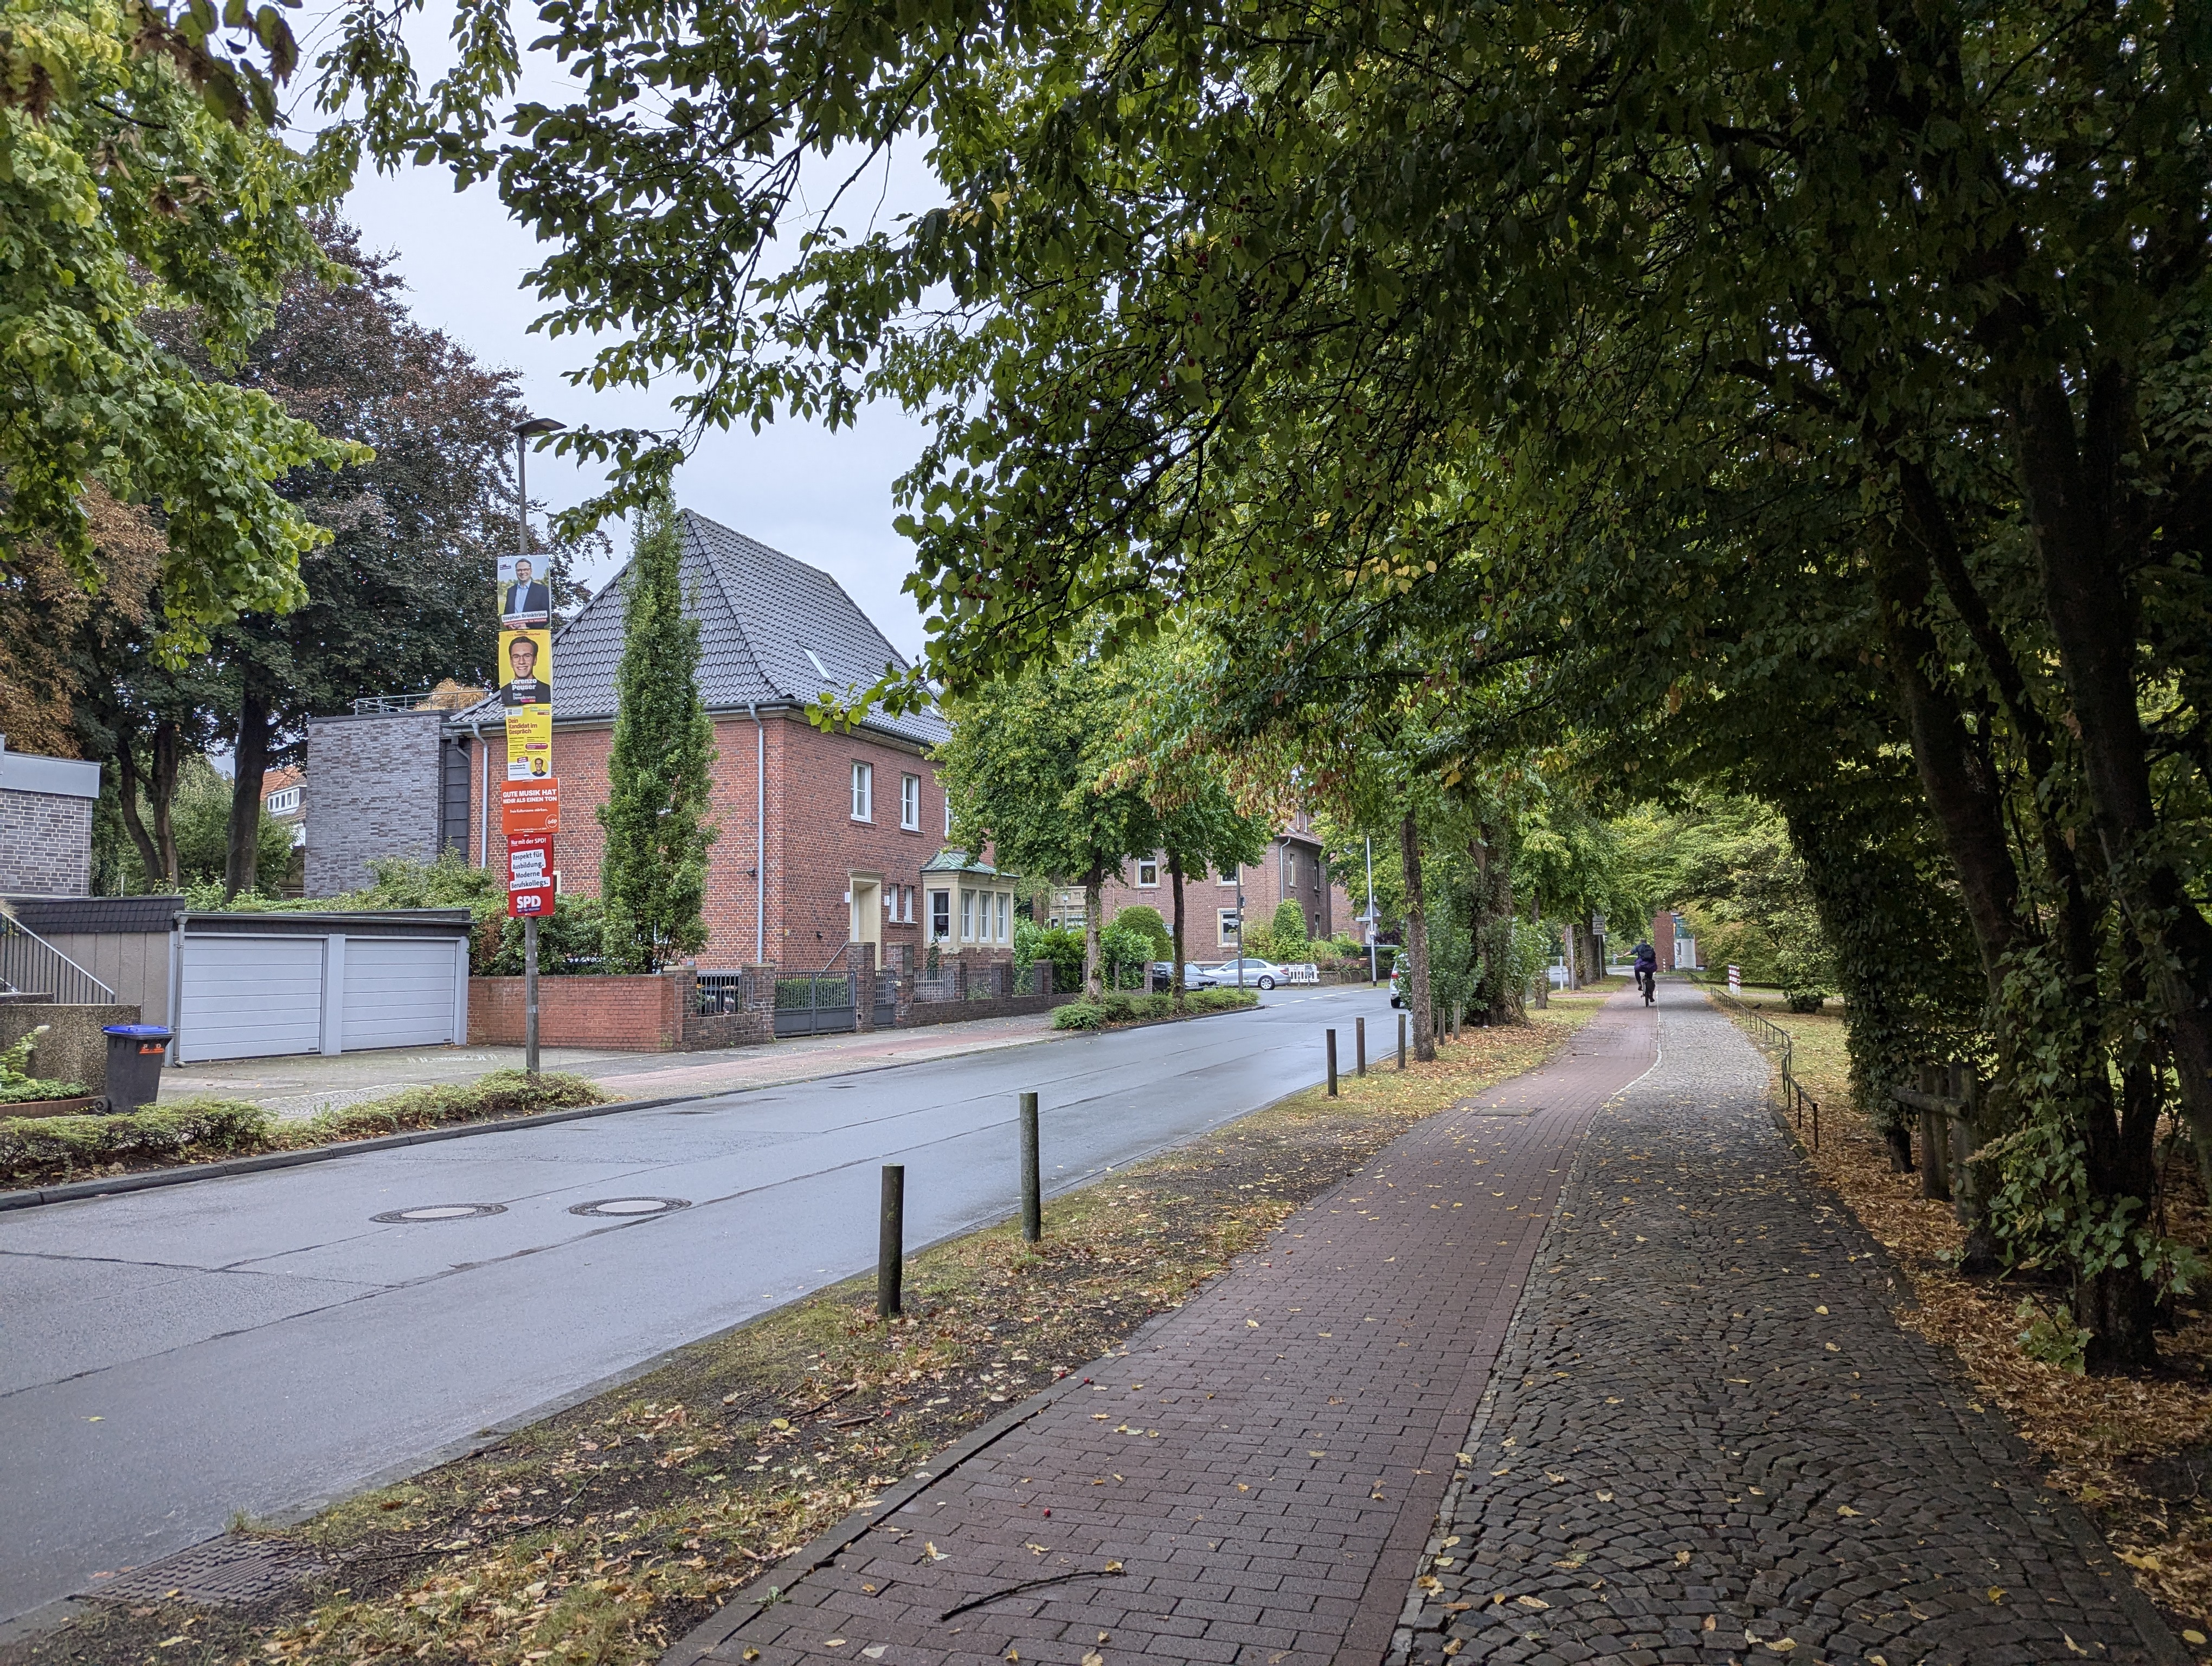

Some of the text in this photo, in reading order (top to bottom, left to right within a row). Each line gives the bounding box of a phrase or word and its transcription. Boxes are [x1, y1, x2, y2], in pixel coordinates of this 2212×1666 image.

[512, 852, 532, 861] Respekt
[512, 861, 544, 870] Ausbildung.
[511, 880, 549, 889] Berufskollegs.
[517, 895, 541, 908] SPD
